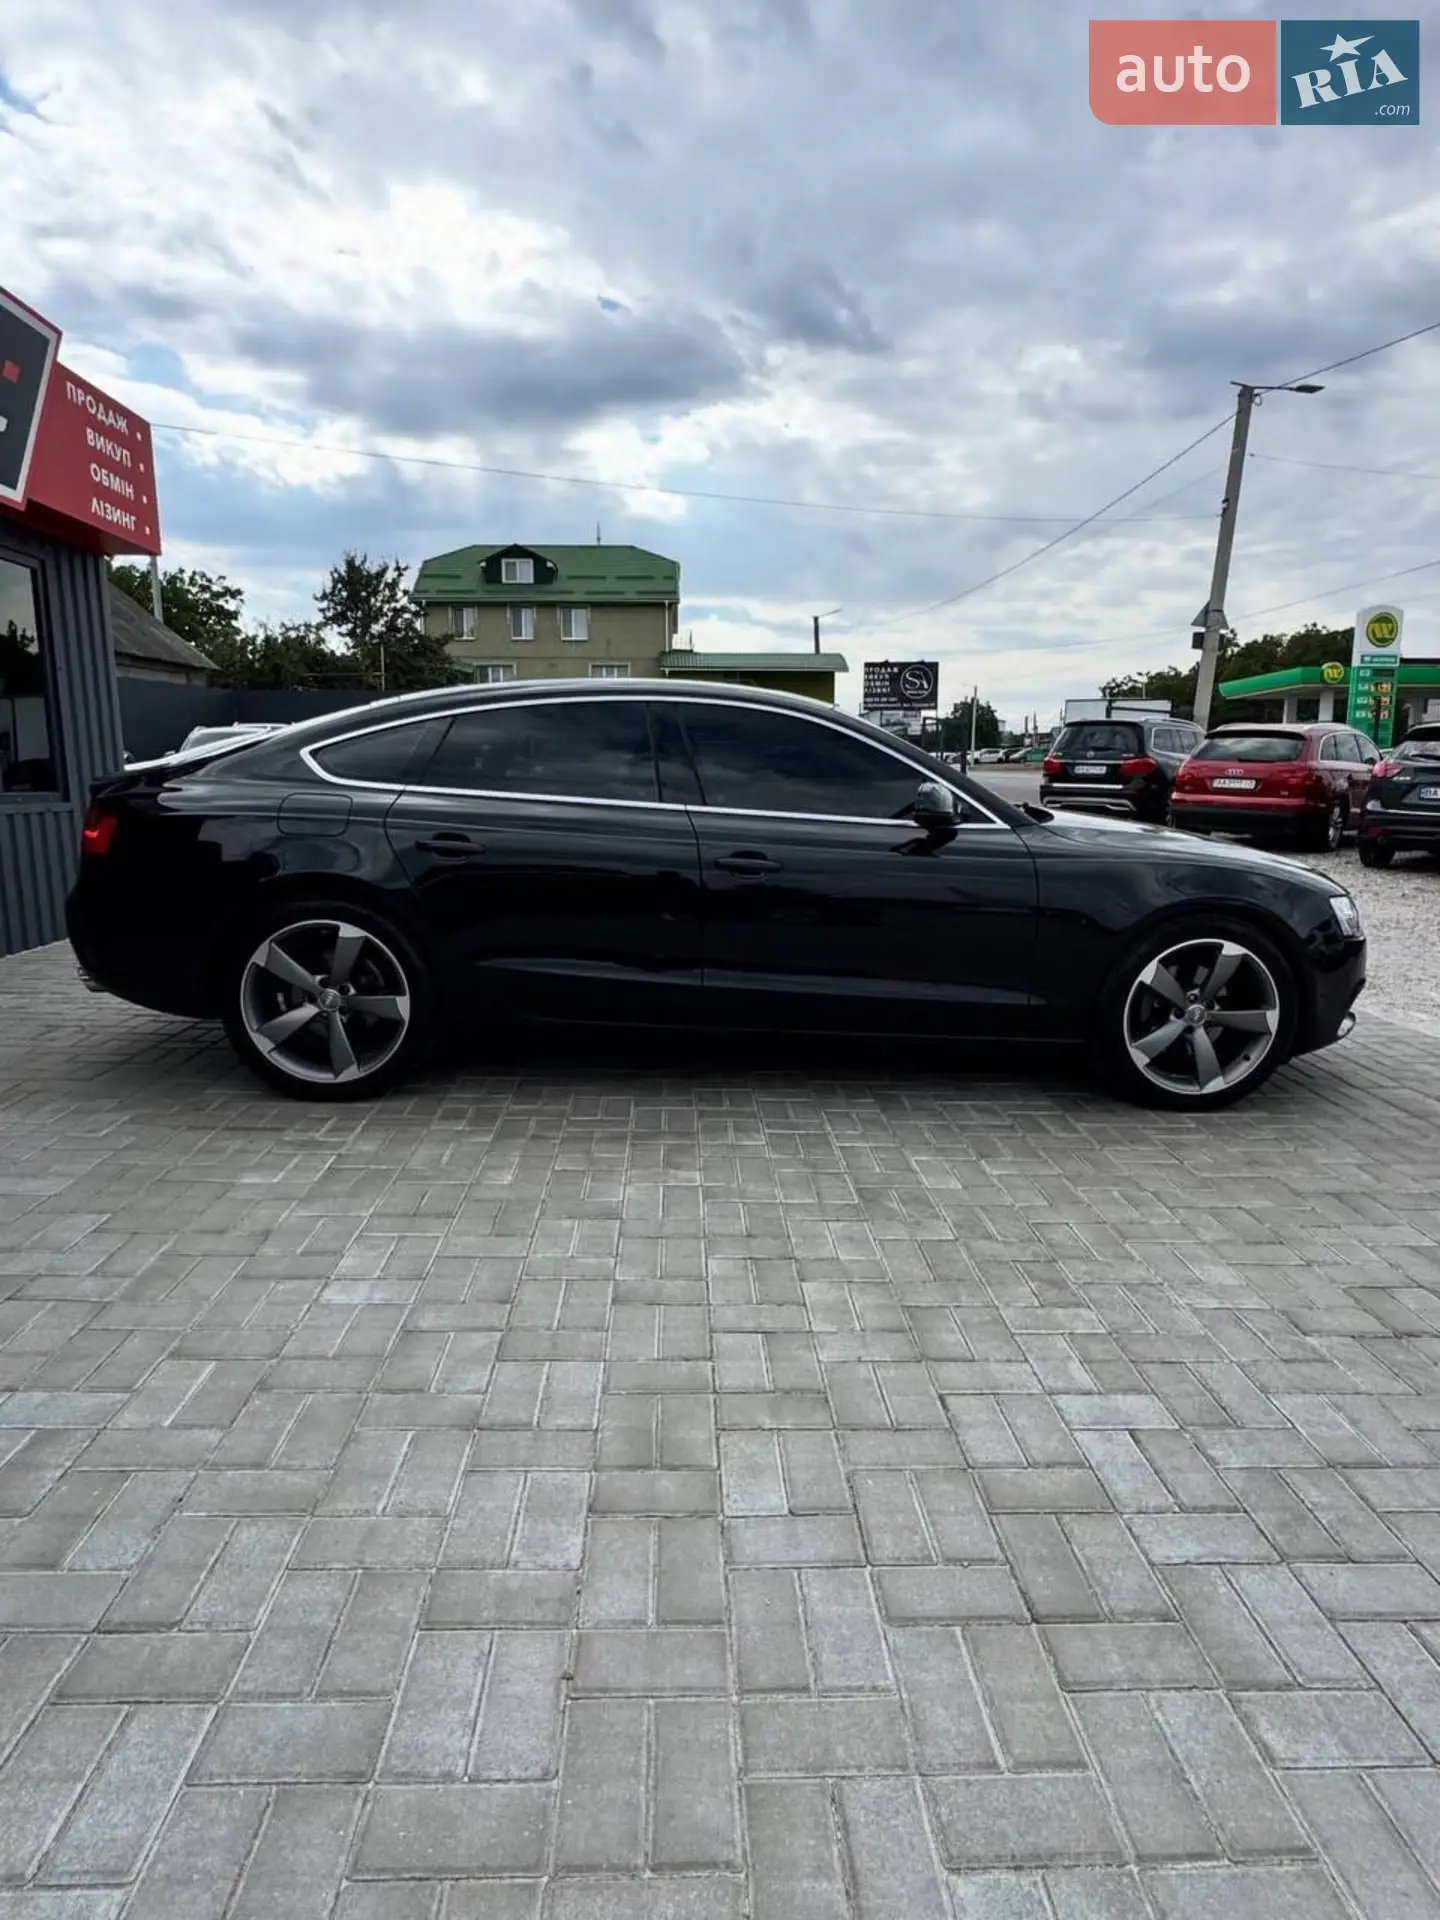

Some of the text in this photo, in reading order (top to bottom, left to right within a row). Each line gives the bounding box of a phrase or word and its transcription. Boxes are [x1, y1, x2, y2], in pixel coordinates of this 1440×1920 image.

[65, 381, 129, 436] ПРОДАЖ
[86, 428, 131, 467] ВИКУП
[90, 463, 134, 500] ОБМІН
[91, 497, 136, 532] ЛІЗИНГ
